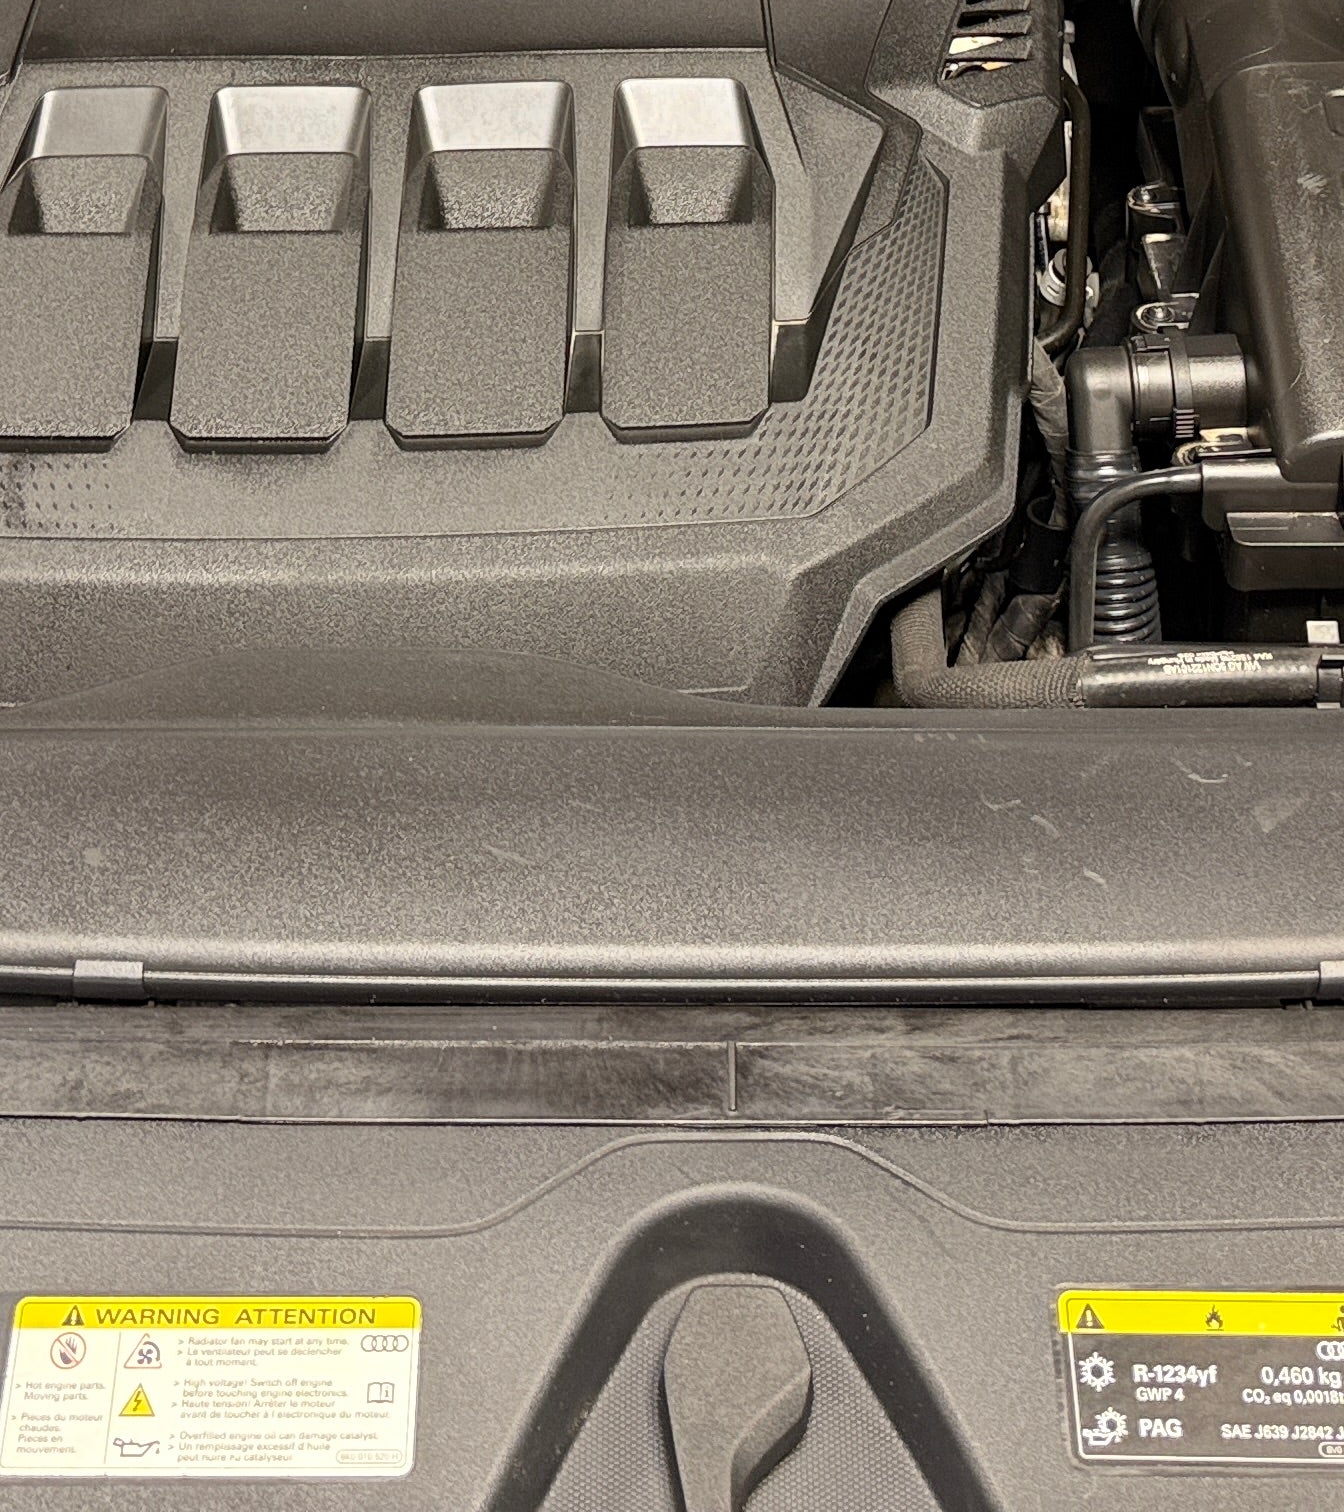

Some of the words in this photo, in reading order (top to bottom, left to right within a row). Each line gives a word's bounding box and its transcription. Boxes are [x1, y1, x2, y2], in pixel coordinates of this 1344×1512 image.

[96, 1308, 221, 1326] WARNING
[234, 1307, 377, 1325] ATTENTION
[230, 1337, 246, 1346] fan
[248, 1338, 269, 1348] may
[271, 1337, 293, 1346] start
[295, 1337, 305, 1346] at
[306, 1338, 324, 1348] any
[187, 1347, 199, 1356] Le
[201, 1346, 251, 1356] ventilateur
[253, 1348, 276, 1358] peut
[194, 1357, 214, 1366] tout
[1131, 1364, 1219, 1388] R-1234yf
[1260, 1366, 1315, 1387] 0,460
[1318, 1366, 1344, 1389] kg
[25, 1381, 42, 1390] Hot
[44, 1382, 79, 1393] engine
[184, 1378, 207, 1390] High
[250, 1378, 283, 1388] Switch
[285, 1378, 300, 1388] off
[300, 1379, 334, 1390] engine
[23, 1392, 60, 1402] Moving
[182, 1389, 214, 1399] before
[216, 1389, 258, 1400] touching
[261, 1389, 294, 1400] engine
[1135, 1386, 1173, 1402] GWP
[1173, 1386, 1187, 1402] 4
[1272, 1391, 1293, 1406] eq
[181, 1399, 211, 1409] Haute
[289, 1399, 299, 1409] le
[300, 1399, 336, 1409] moteur
[53, 1412, 66, 1422] du
[69, 1413, 104, 1422] moteur
[180, 1410, 207, 1419] avant
[209, 1409, 222, 1419] de
[223, 1409, 261, 1419] toucher
[338, 1409, 352, 1419] du
[1138, 1417, 1184, 1438] PAG
[1220, 1423, 1253, 1440] SAE
[1254, 1424, 1290, 1440] J639
[1291, 1424, 1334, 1441] J2842
[51, 1434, 63, 1443] en
[179, 1431, 227, 1441] Overfilled
[229, 1431, 262, 1442] engine
[264, 1430, 277, 1440] oil
[278, 1432, 296, 1441] can
[298, 1431, 338, 1442] damage
[178, 1442, 193, 1451] Un
[195, 1442, 254, 1453] remplissage
[256, 1442, 296, 1451] excessif
[177, 1454, 200, 1463] peut
